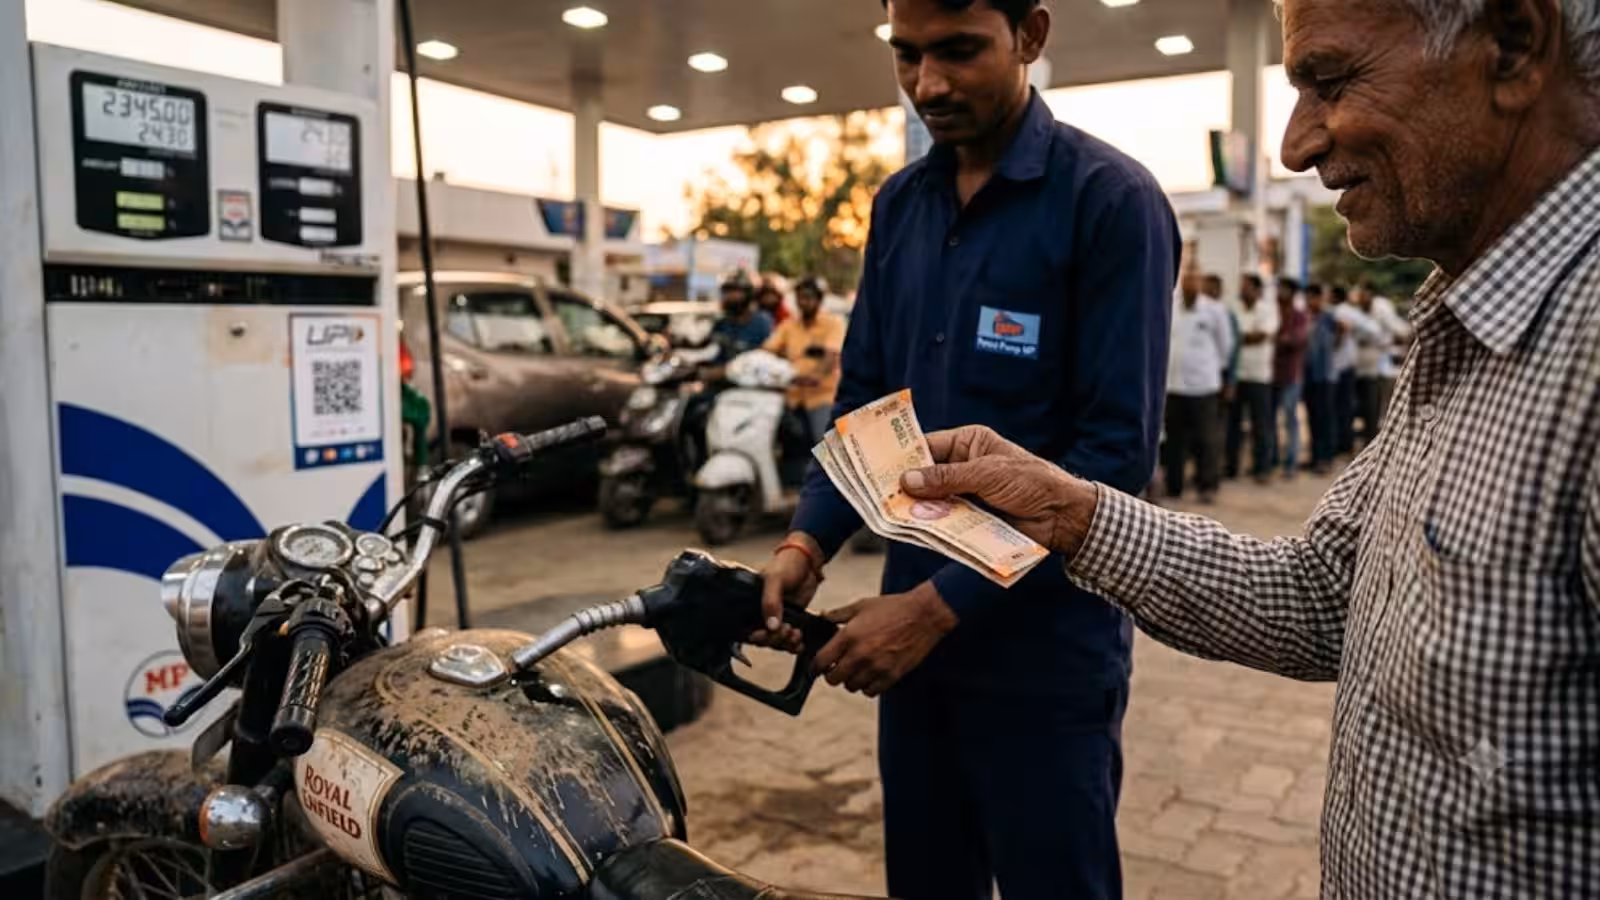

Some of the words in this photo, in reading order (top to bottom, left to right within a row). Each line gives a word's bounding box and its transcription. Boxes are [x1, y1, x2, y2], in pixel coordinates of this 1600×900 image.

[307, 325, 356, 346] UPI
[304, 765, 352, 812] ROYAL
[302, 788, 362, 840] ENFIELD
